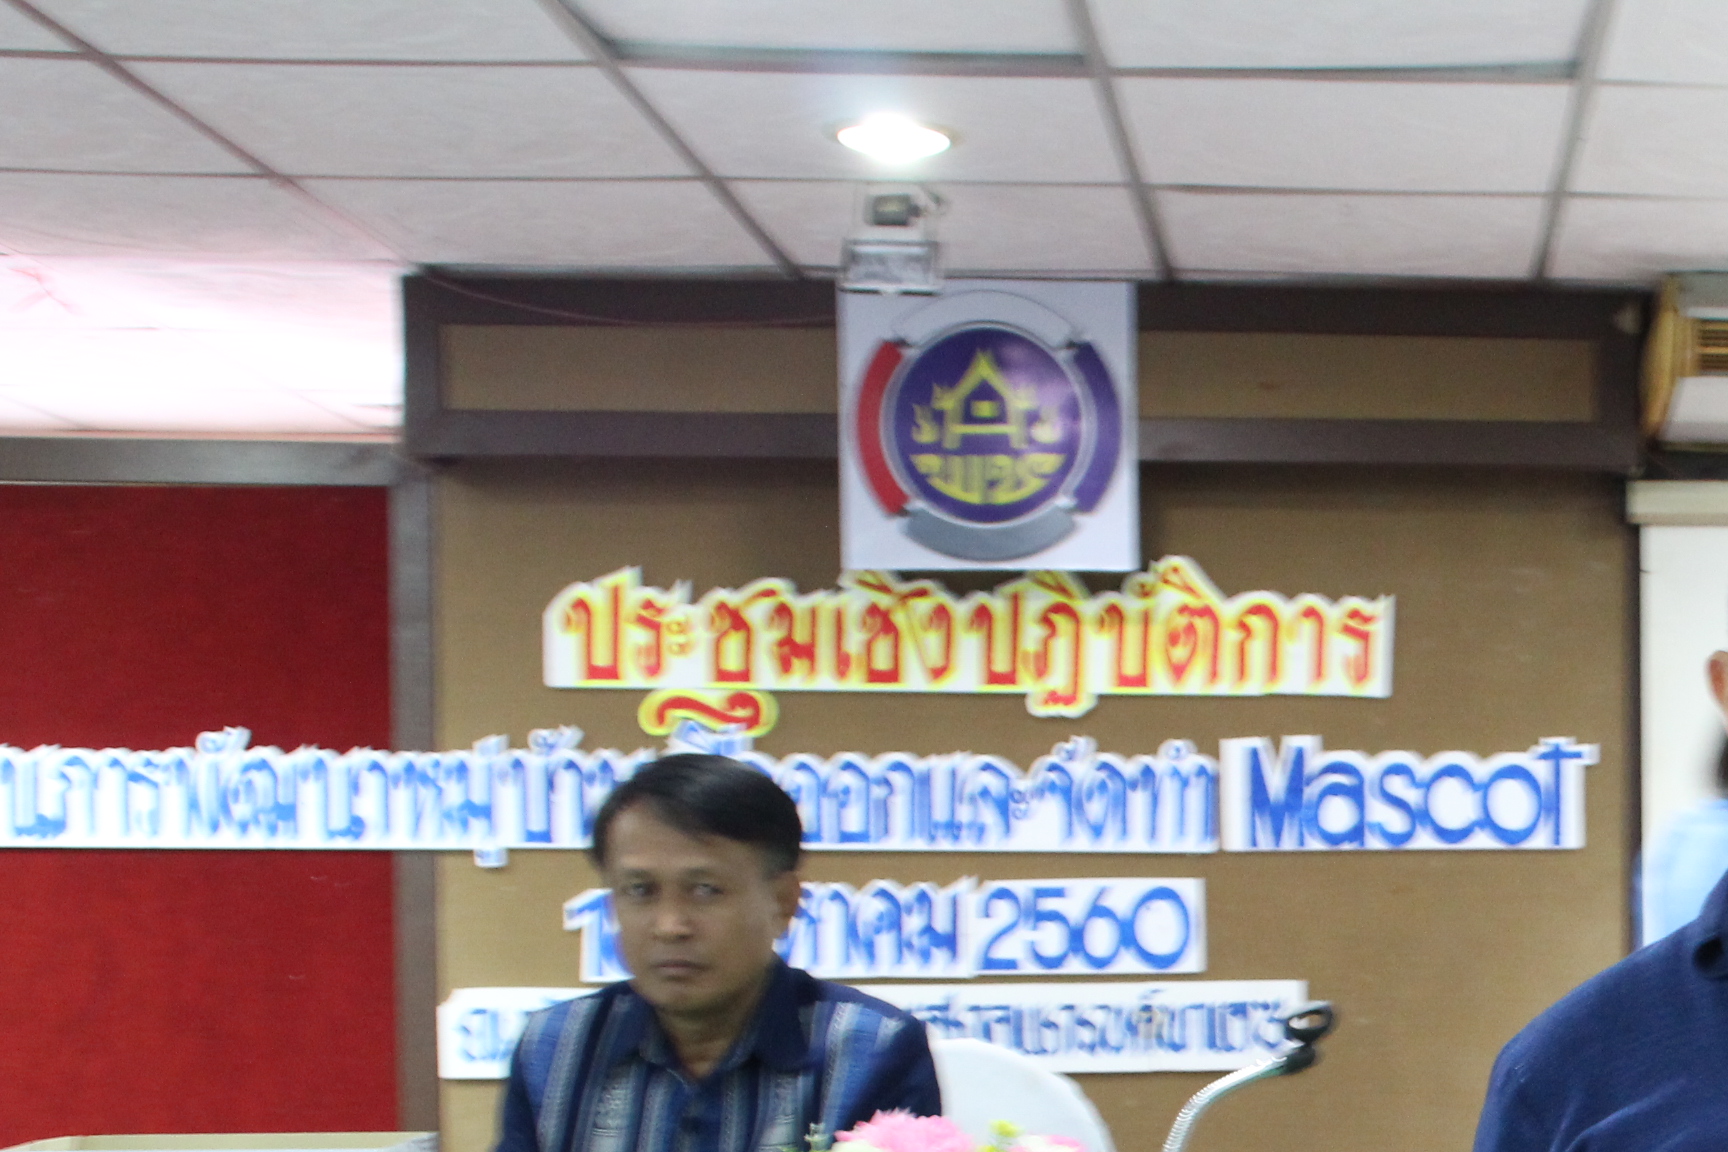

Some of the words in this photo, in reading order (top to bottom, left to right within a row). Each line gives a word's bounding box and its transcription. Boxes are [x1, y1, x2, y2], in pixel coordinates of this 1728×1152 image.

[557, 562, 1388, 735] ประชุมเชิงปฏิบัติการ
[1248, 740, 1584, 850] Mascot
[566, 893, 630, 982] 1
[983, 888, 1194, 970] 2560
